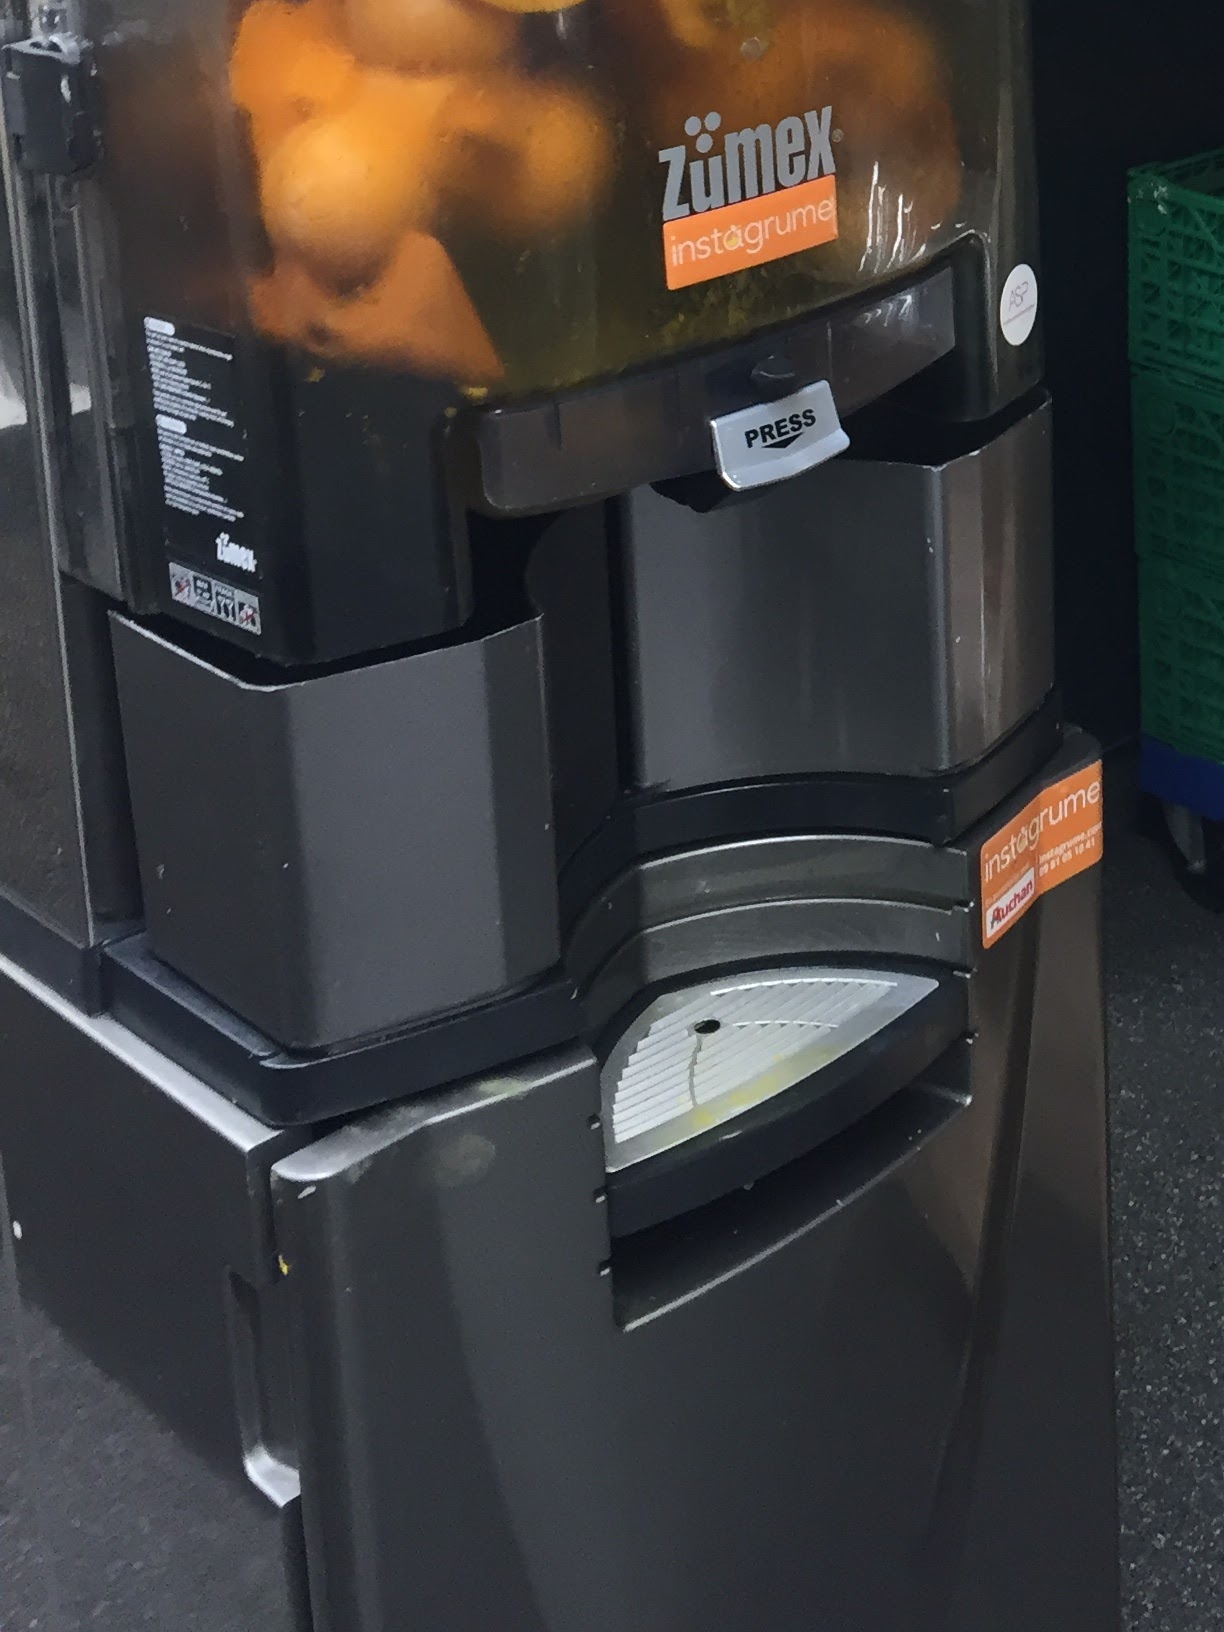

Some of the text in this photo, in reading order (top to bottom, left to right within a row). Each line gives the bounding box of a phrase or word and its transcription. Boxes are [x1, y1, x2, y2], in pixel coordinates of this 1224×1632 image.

[671, 197, 835, 267] instagrume
[744, 409, 816, 449] PRESS
[985, 781, 1100, 883] instagrume
[990, 879, 1033, 929] Auchan
